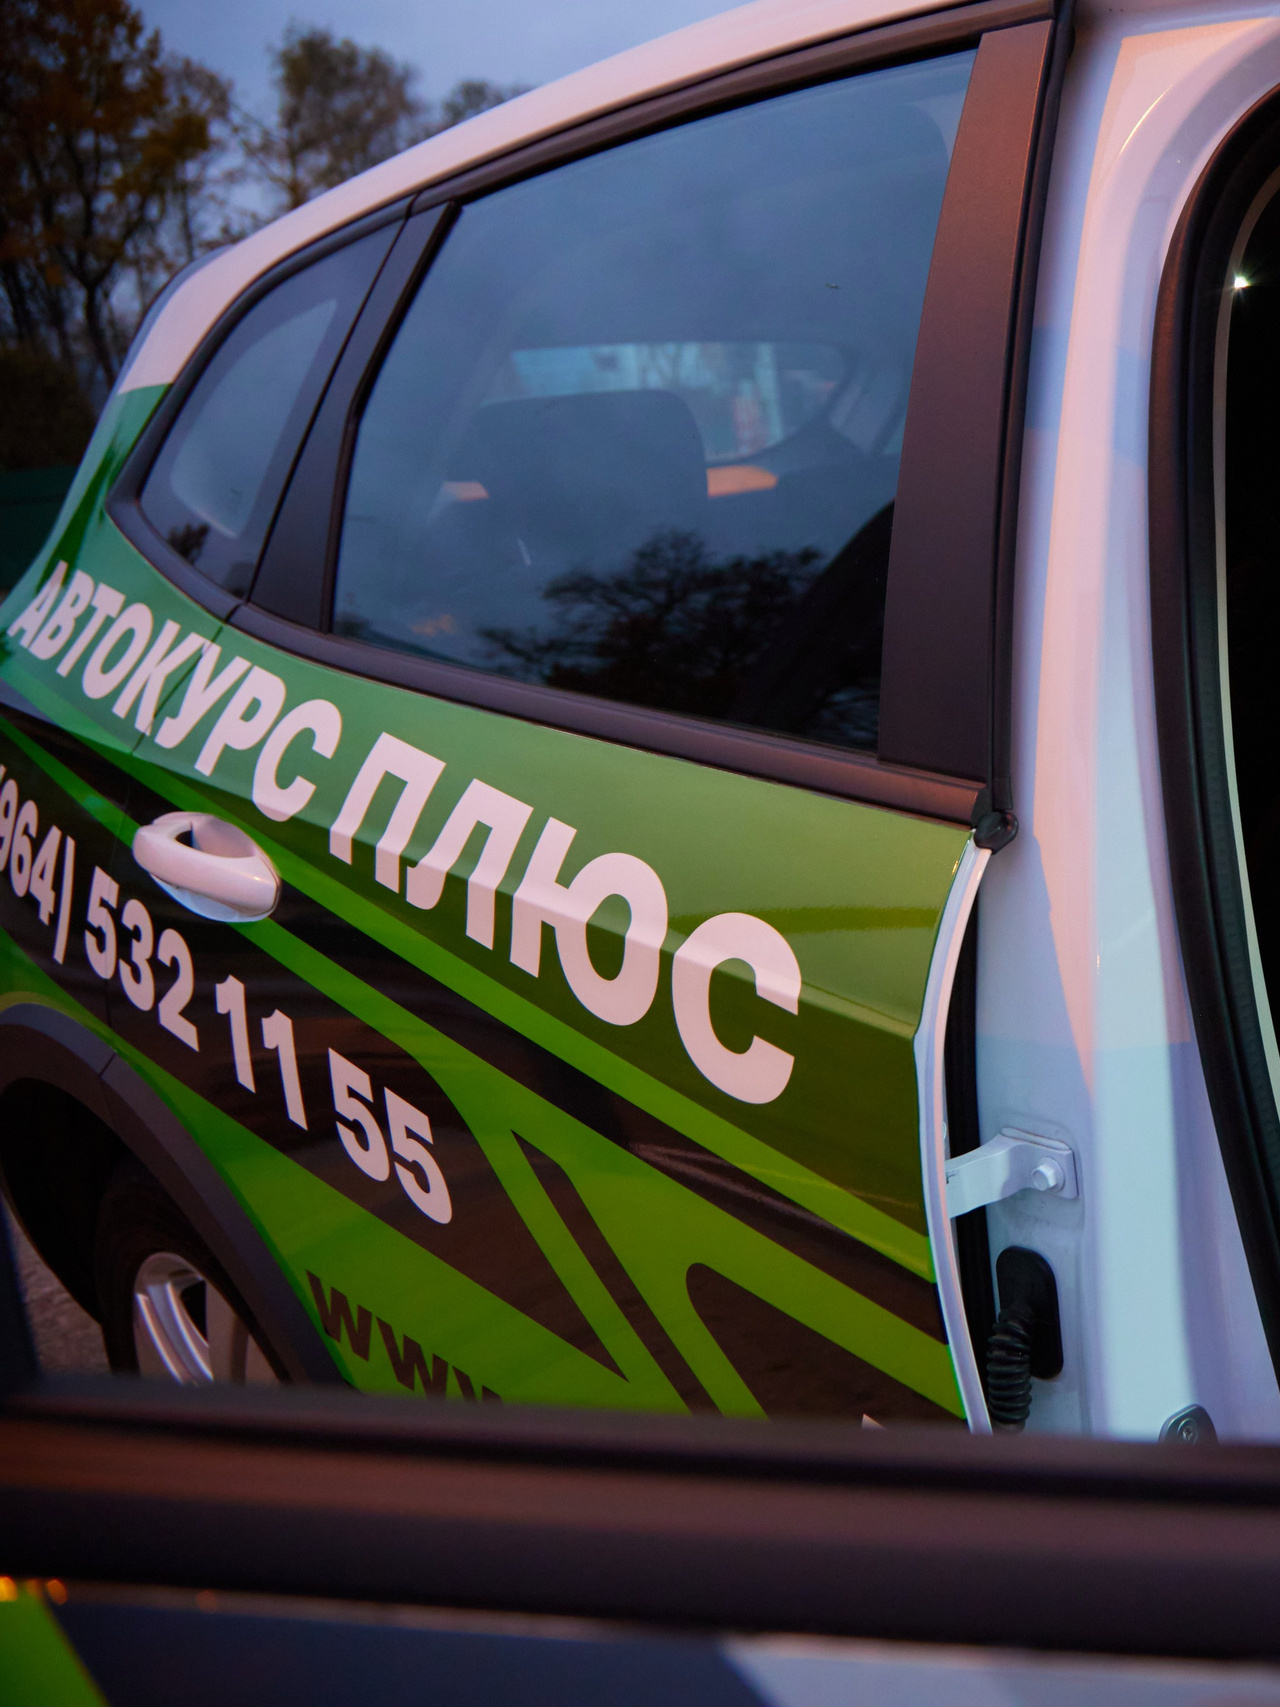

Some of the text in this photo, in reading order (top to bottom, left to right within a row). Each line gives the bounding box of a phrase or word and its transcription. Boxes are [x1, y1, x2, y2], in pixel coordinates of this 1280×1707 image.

[7, 559, 803, 1106] АВТОКУРС ПЛЮС
[84, 864, 200, 1053] 532
[214, 973, 309, 1132] 11
[327, 1046, 453, 1225] 55
